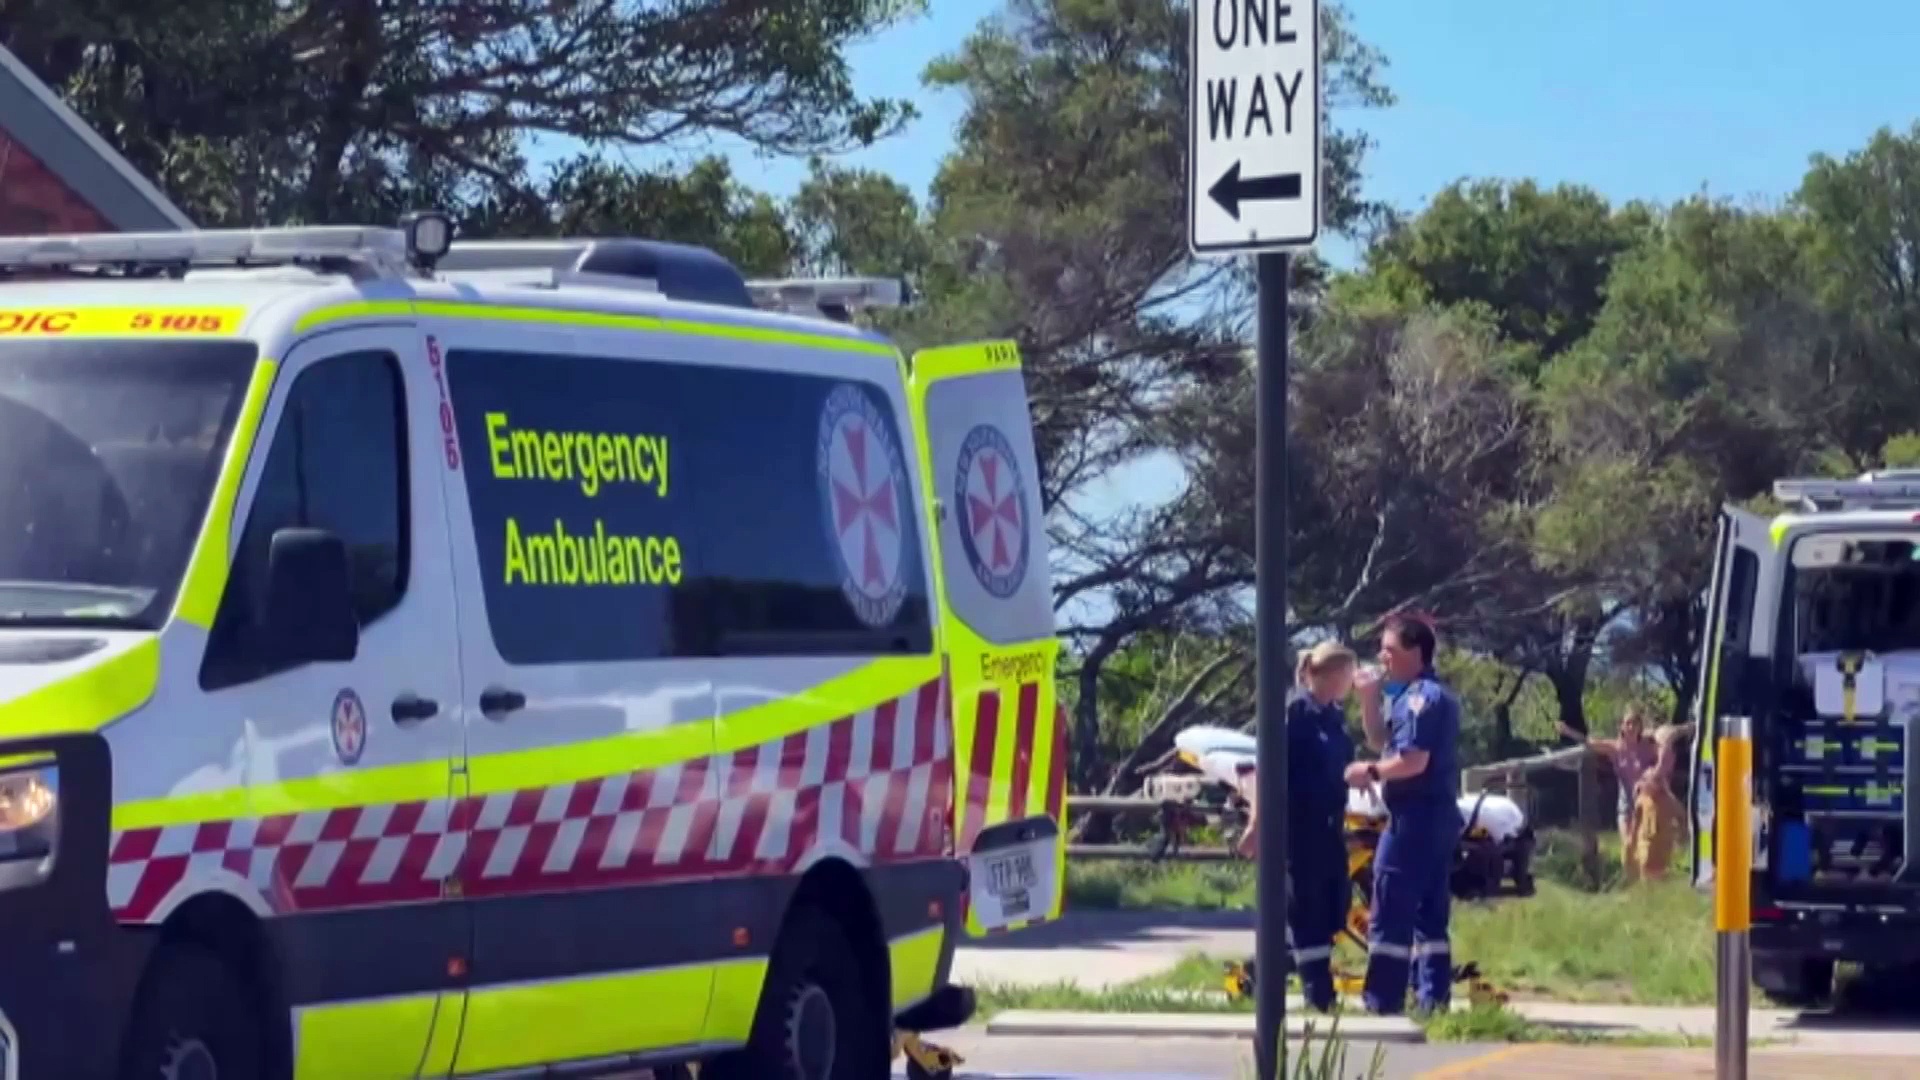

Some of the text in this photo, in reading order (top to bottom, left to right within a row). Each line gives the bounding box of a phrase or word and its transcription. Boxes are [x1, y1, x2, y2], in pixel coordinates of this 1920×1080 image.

[1213, 0, 1297, 50] ONE
[1207, 69, 1302, 140] WAY
[130, 313, 222, 332] 5105
[485, 412, 670, 497] Emergency
[503, 517, 682, 586] Ambulance
